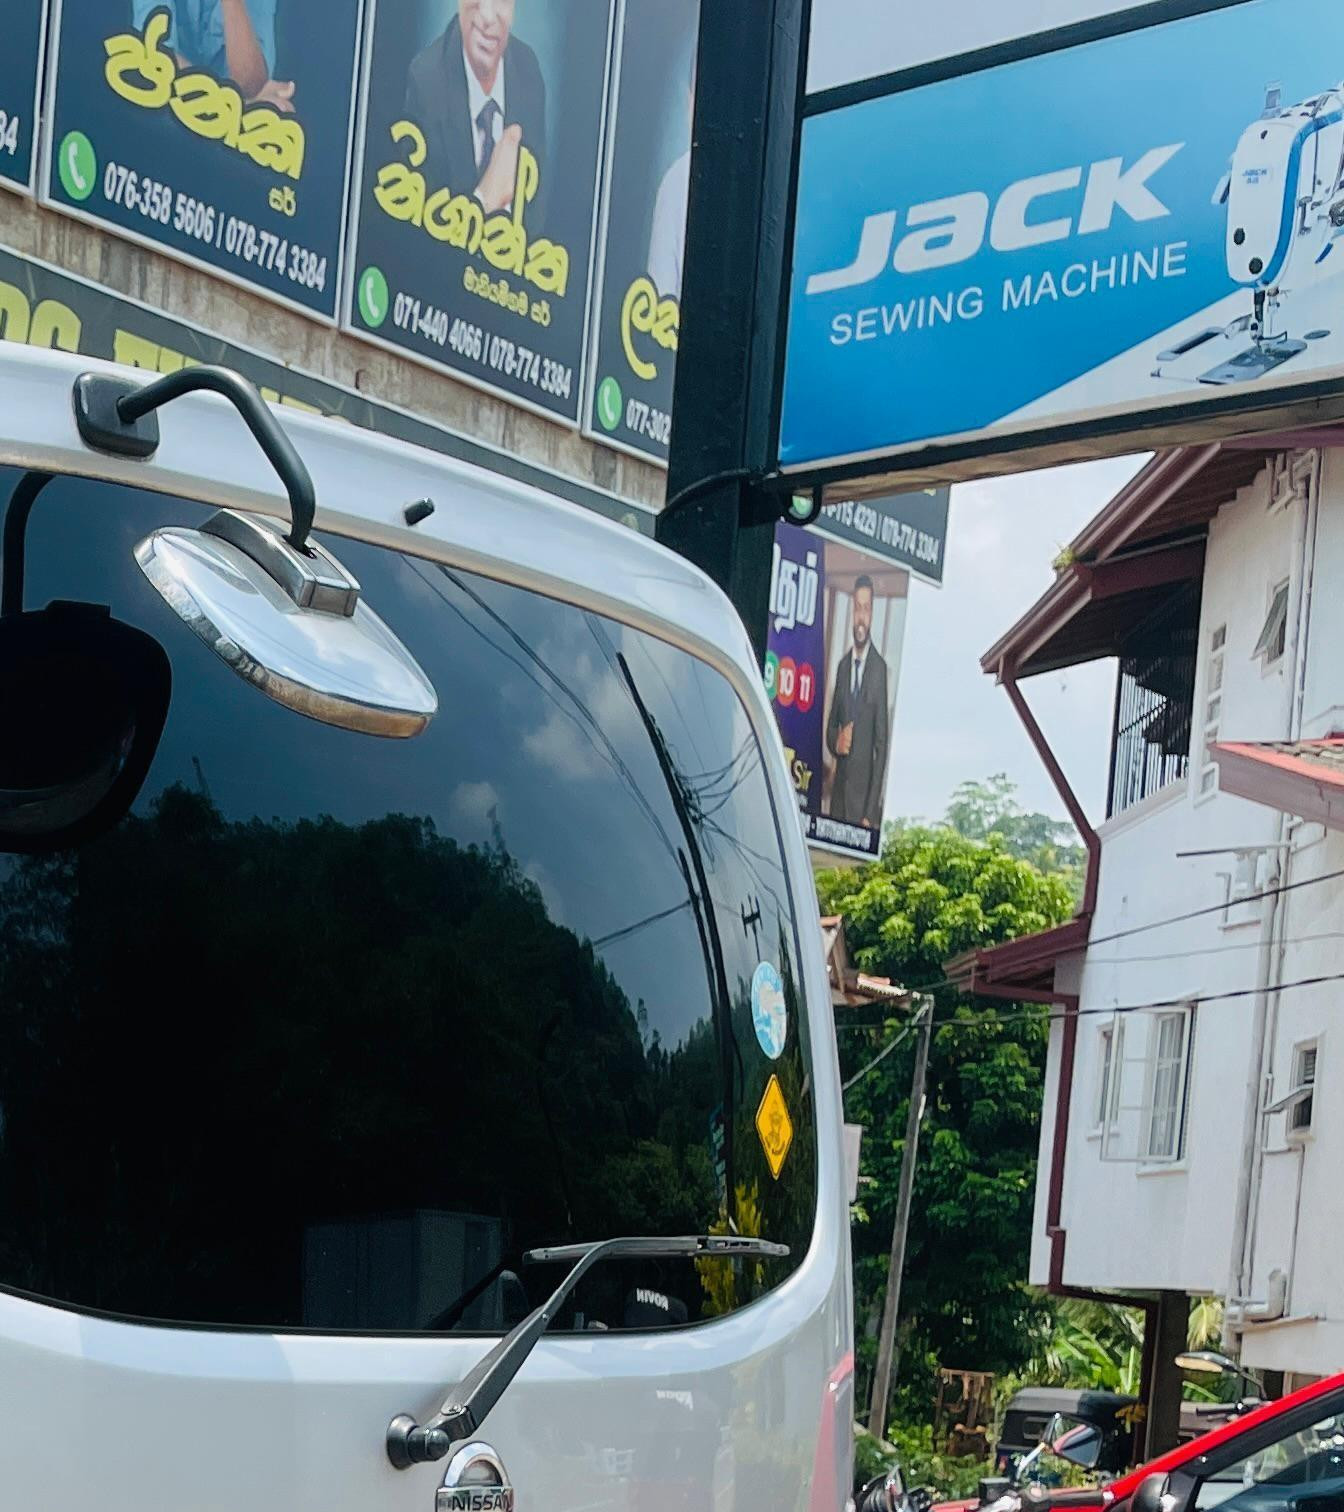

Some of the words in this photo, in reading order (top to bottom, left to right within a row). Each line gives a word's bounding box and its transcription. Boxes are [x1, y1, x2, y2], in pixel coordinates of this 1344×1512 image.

[104, 161, 173, 226] 076-358
[173, 192, 216, 245] 5606
[226, 217, 288, 276] 078-774
[287, 245, 328, 292] 3384
[393, 292, 449, 346] 071-440
[449, 318, 483, 361] 4066
[490, 335, 540, 386] 078-774
[540, 358, 573, 399] 3384
[830, 287, 984, 346] SEWING
[1002, 242, 1188, 311] MACHINE
[779, 668, 795, 697] 10
[798, 672, 811, 700] 11
